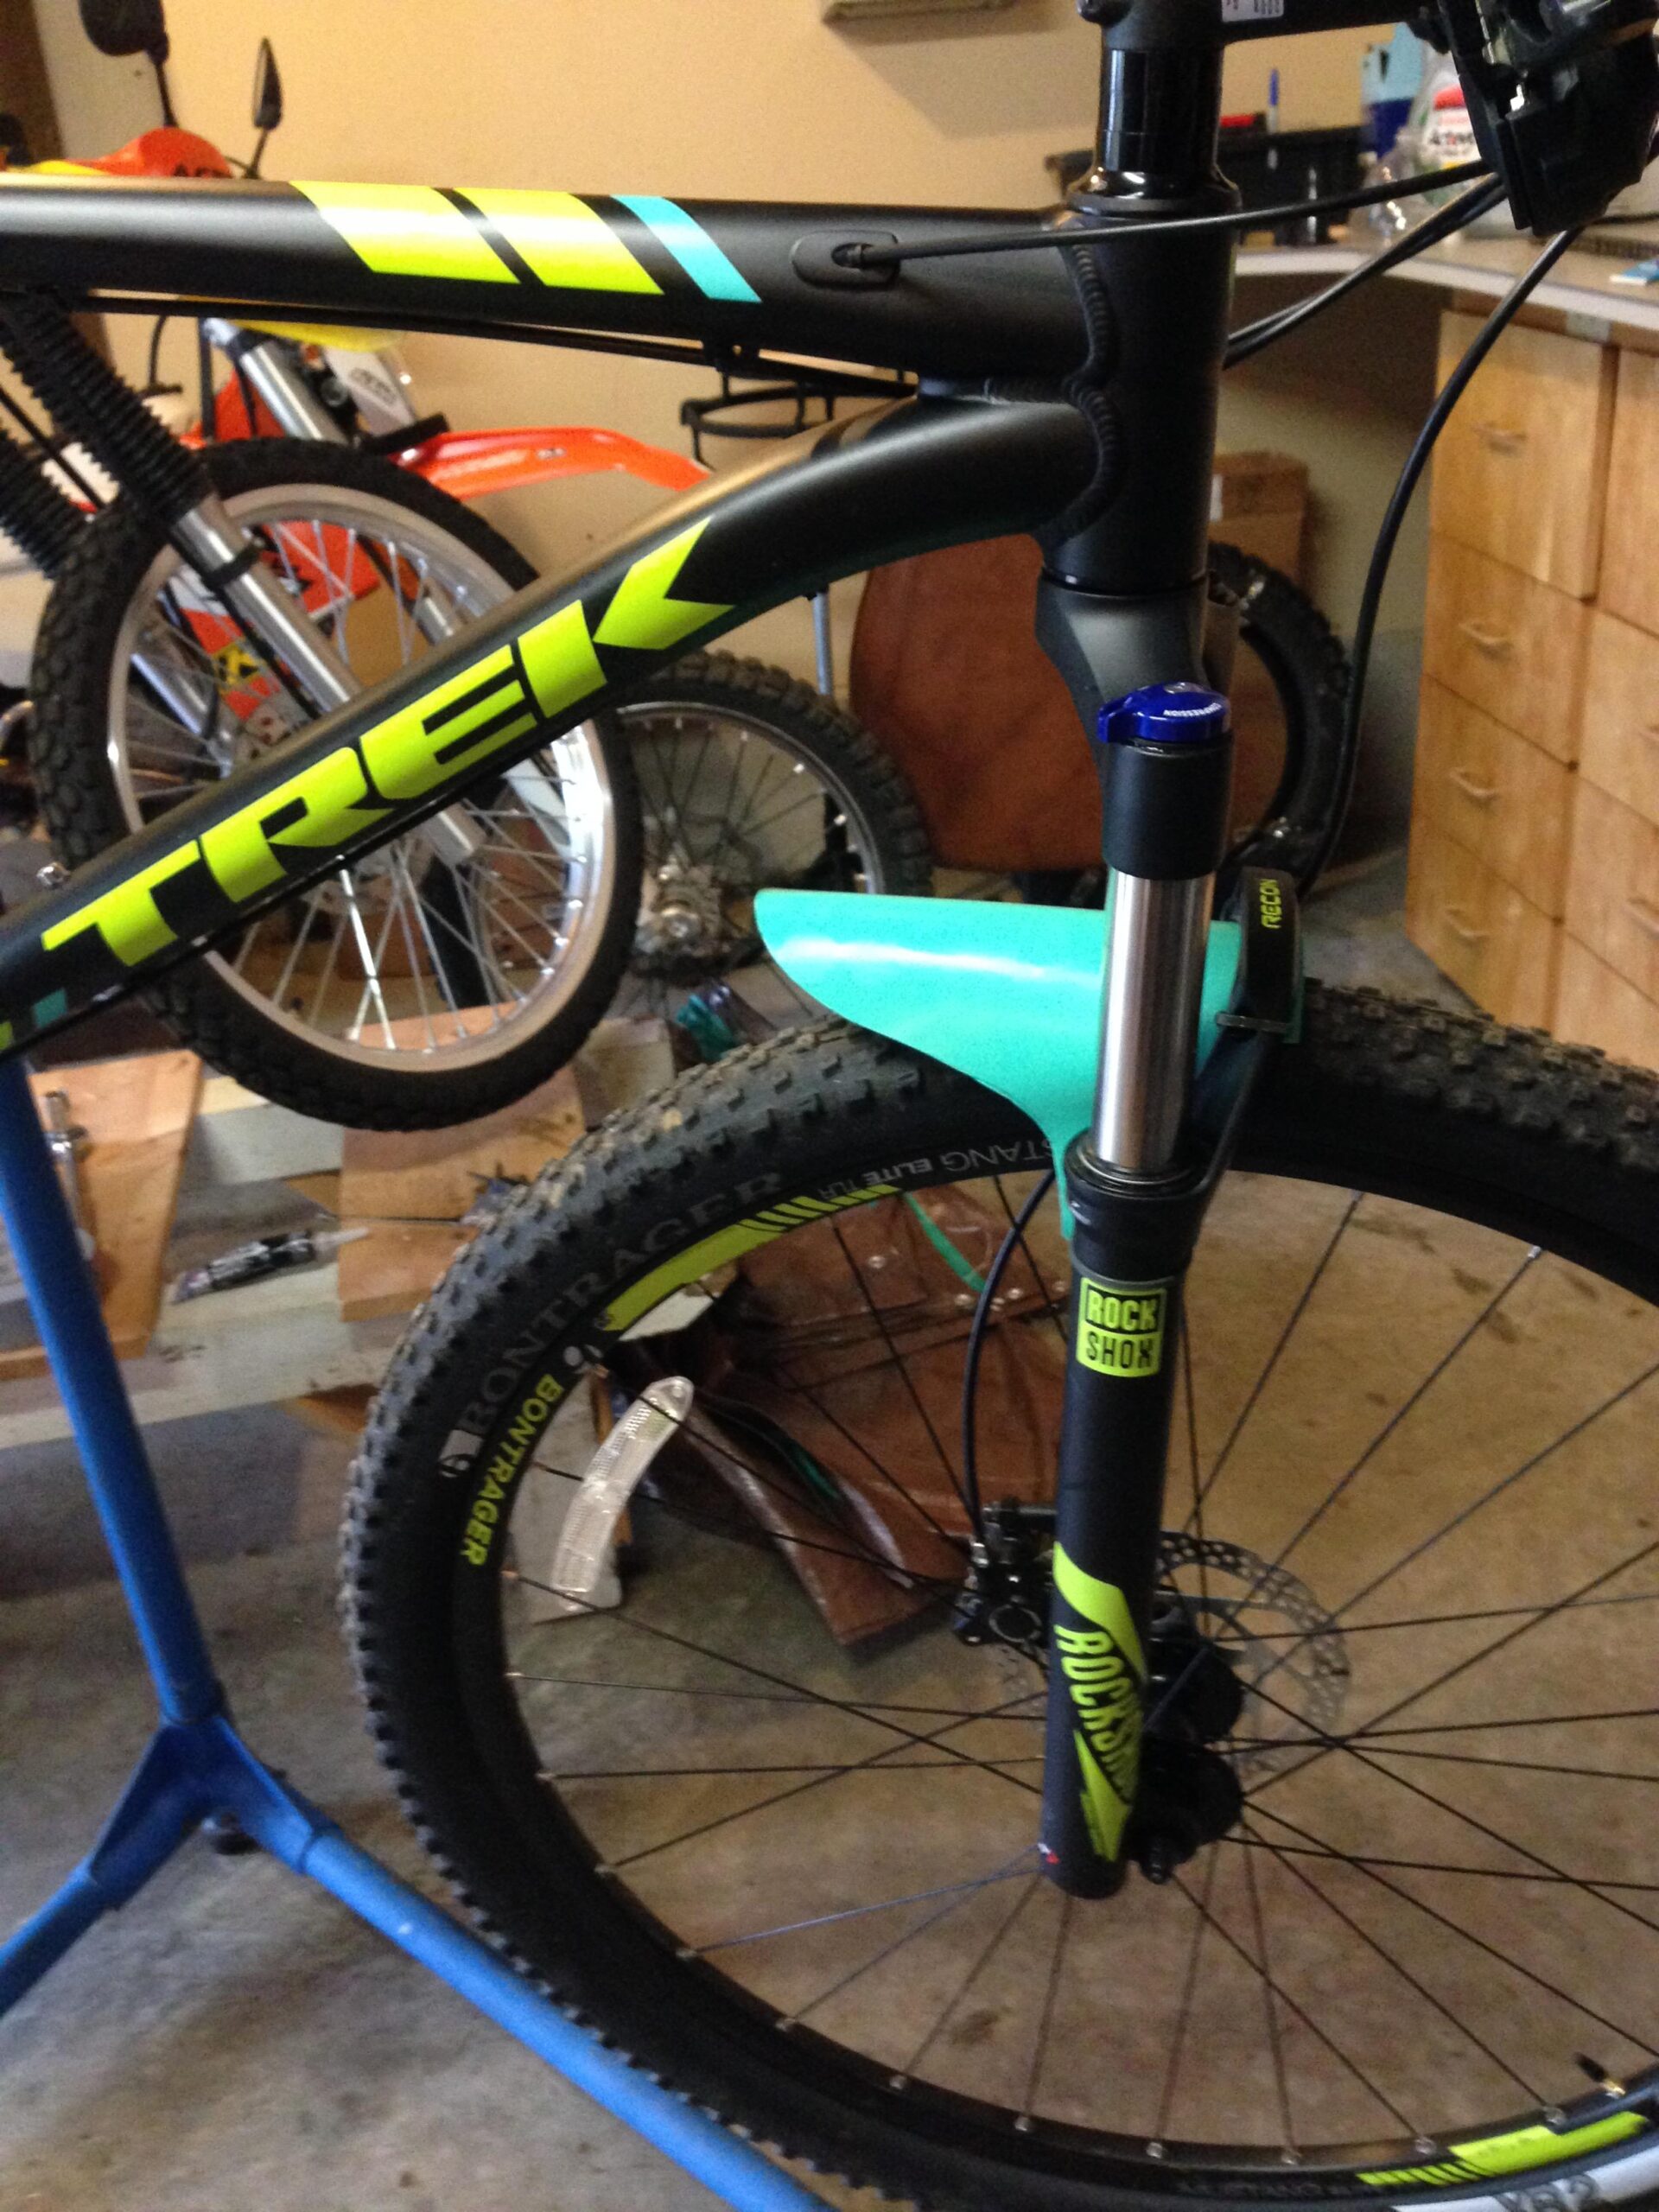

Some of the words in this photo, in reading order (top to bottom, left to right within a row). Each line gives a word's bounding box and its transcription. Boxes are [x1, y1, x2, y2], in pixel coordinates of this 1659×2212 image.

[41, 517, 735, 965] TREK
[1261, 879, 1282, 929] RECON
[818, 1179, 856, 1200] TLR
[861, 1159, 933, 1185] ELITE
[456, 1172, 779, 1434] BONTRAGER
[1087, 1290, 1157, 1332] ROCK
[1087, 1332, 1154, 1369] SHOX
[460, 1374, 564, 1566] BONTRAGER
[1053, 1624, 1142, 1803] ROCKSH
